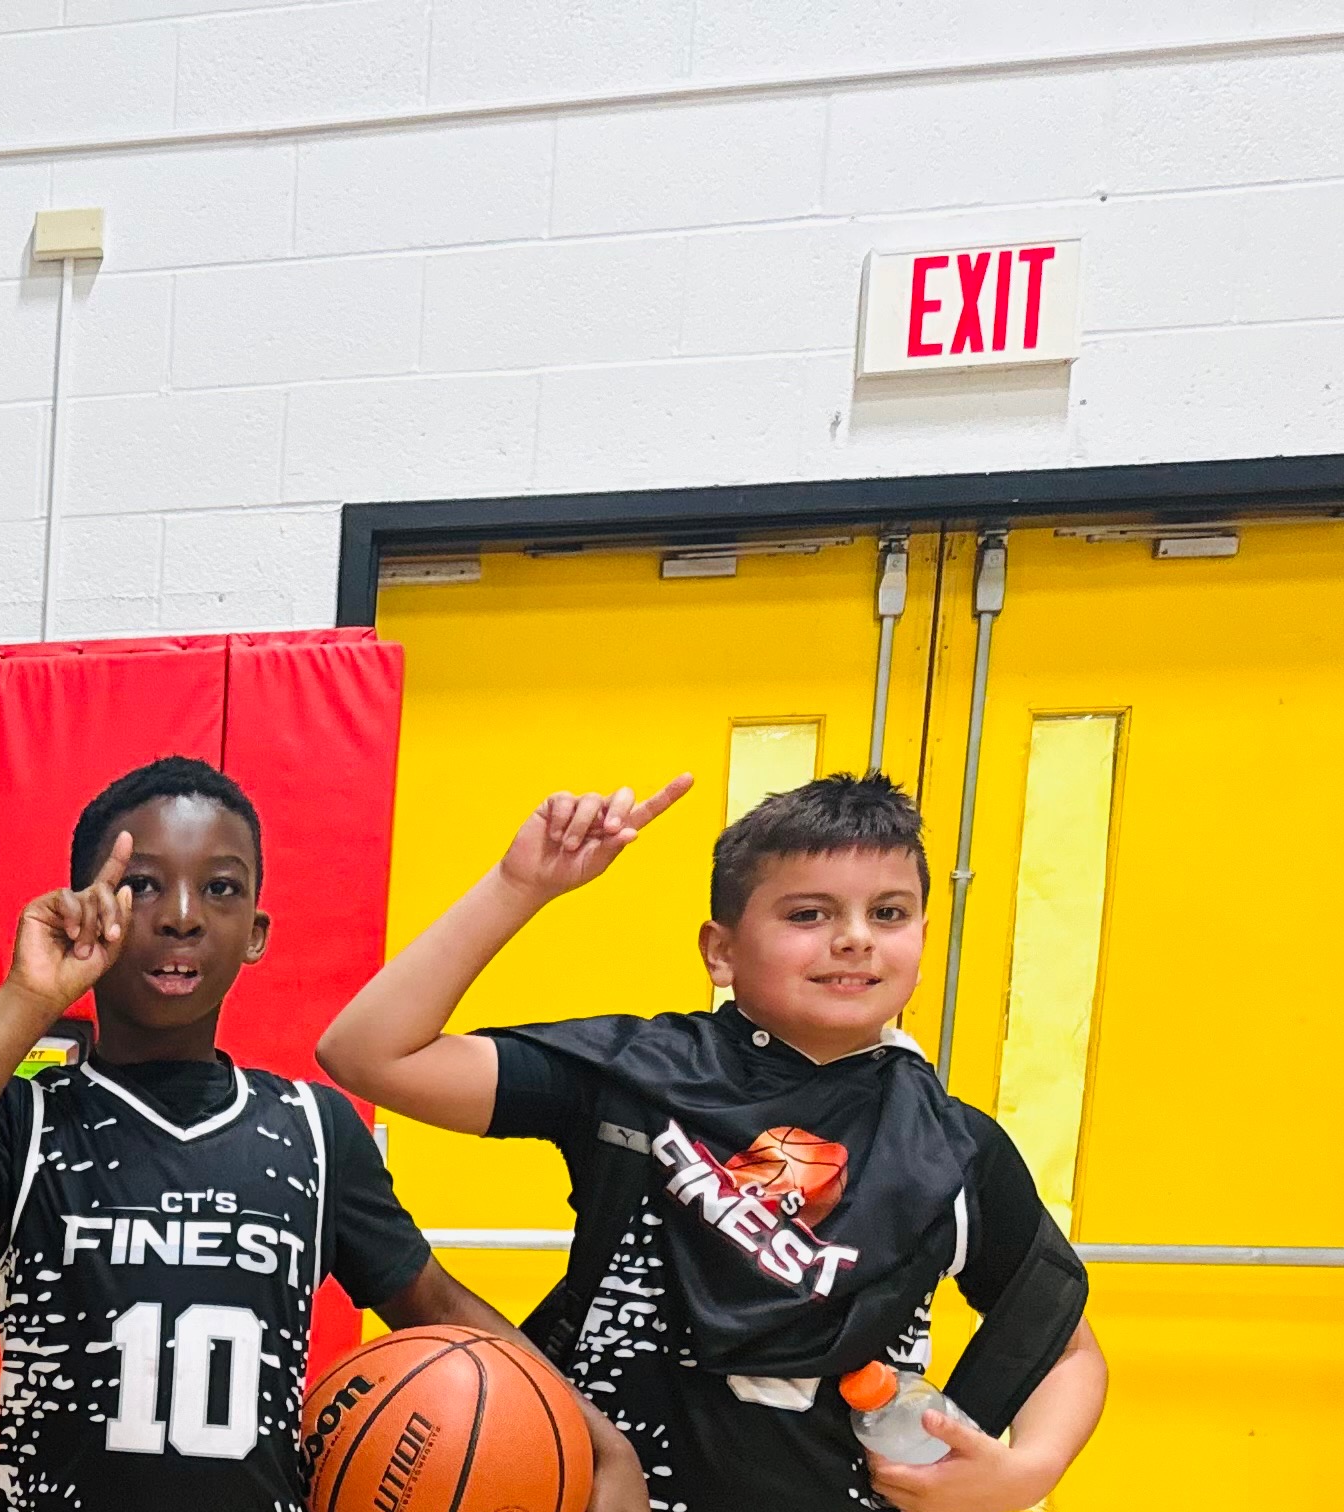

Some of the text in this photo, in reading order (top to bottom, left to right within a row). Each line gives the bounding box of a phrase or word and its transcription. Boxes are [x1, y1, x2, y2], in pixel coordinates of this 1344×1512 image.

[907, 246, 1055, 357] EXIT
[60, 1214, 305, 1289] FINEST
[161, 1188, 238, 1214] CT'S
[651, 1119, 859, 1297] FINEST
[105, 1301, 263, 1461] 10
